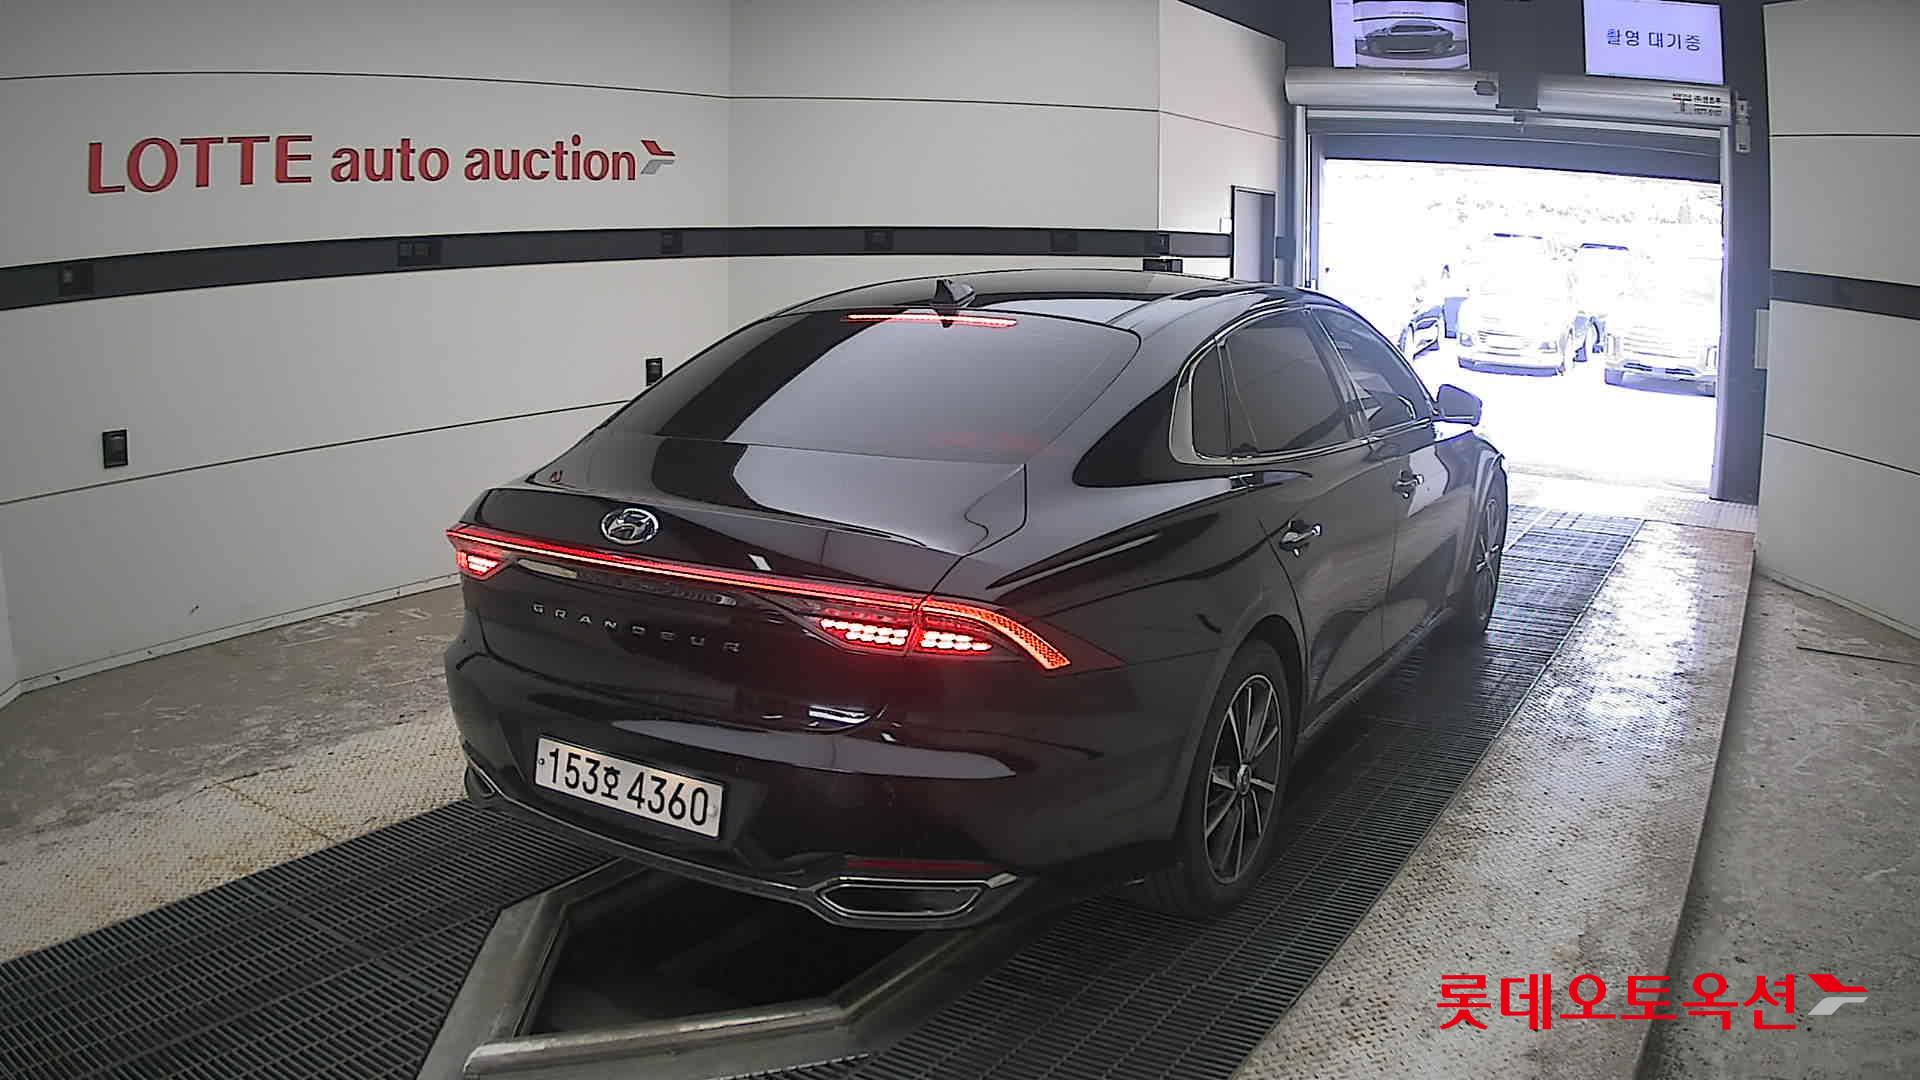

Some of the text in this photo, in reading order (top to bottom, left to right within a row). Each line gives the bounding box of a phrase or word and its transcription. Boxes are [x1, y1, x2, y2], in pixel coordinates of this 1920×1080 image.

[1647, 31, 1701, 52] 대기중
[88, 134, 636, 194] LOTTE auto auction
[533, 602, 741, 653] GRANDEUR
